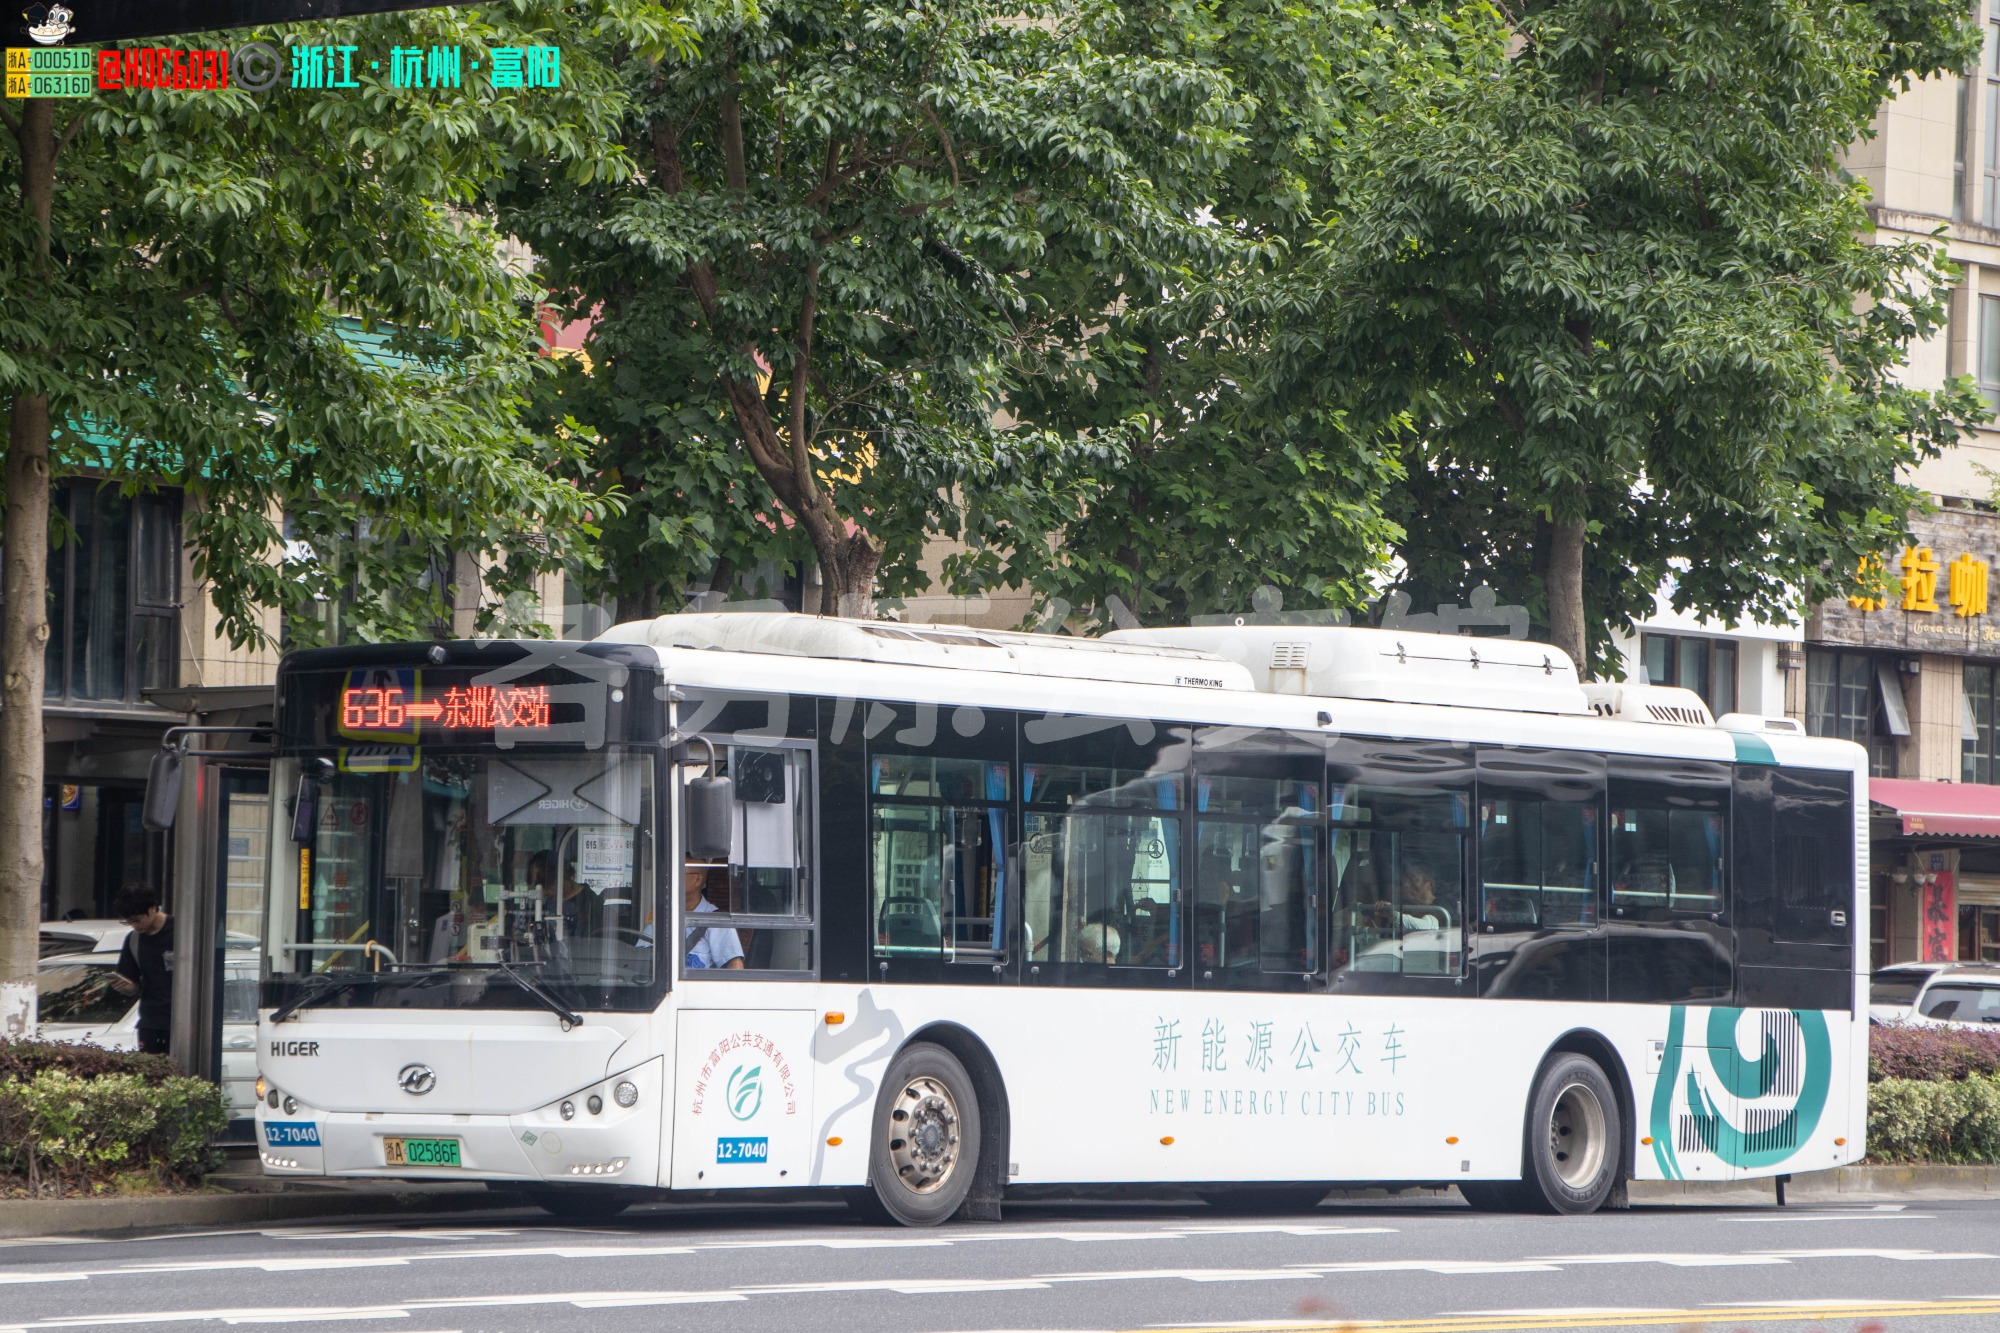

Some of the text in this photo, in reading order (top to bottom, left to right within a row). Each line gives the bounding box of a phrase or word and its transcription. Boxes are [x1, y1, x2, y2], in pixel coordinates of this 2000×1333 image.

[1184, 677, 1208, 686] THERMO
[1208, 679, 1222, 687] KING
[343, 686, 549, 728] 636 东洲公交站
[585, 840, 597, 850] 615
[270, 1041, 320, 1057] HIGER
[1151, 1015, 1407, 1075] 新能源公交车
[692, 1031, 796, 1115] 杭州市富阳公共交通有限公司
[1150, 1089, 1404, 1116] NEW ENERGY CITY BUS
[265, 1126, 318, 1143] 12-7040
[717, 1142, 767, 1159] 12-7040
